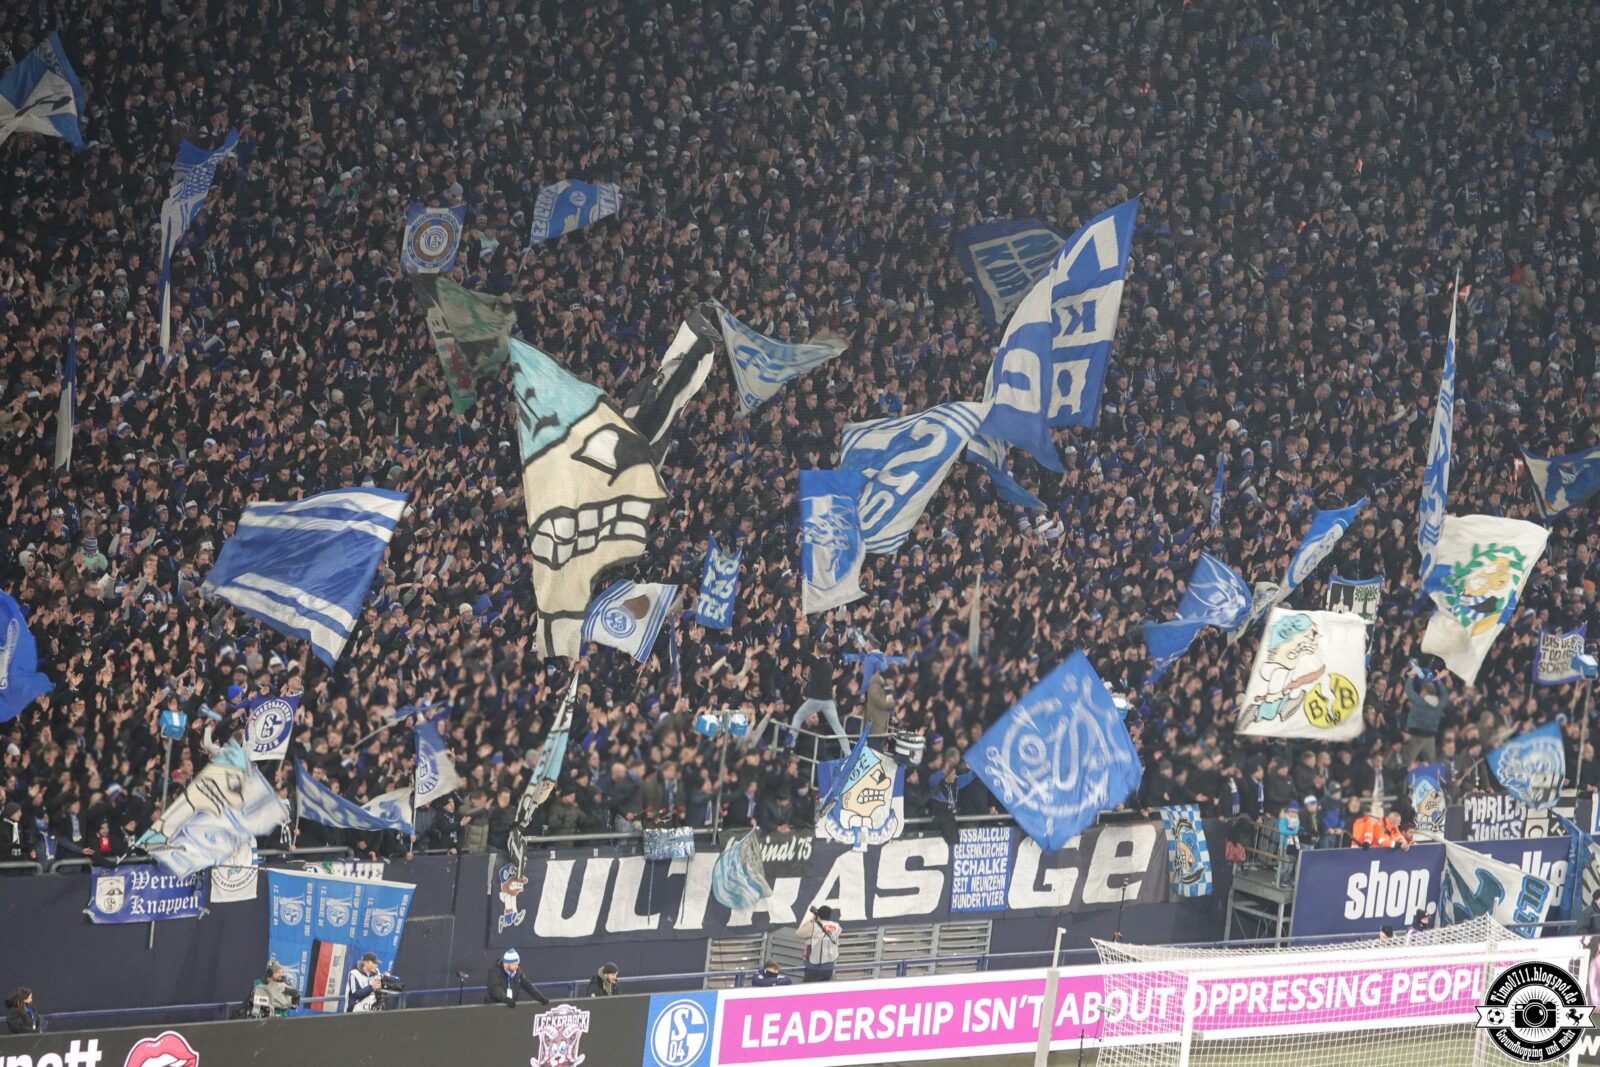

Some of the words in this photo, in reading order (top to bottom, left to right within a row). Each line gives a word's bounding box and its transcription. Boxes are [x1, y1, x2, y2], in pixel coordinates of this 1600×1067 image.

[959, 828, 1010, 842] USSBALLCLUB
[798, 837, 813, 859] 75
[954, 842, 1008, 859] GELSENKIRCHEN
[954, 858, 1007, 876] SCHALKE
[131, 871, 197, 890] Werrata
[953, 877, 968, 893] SEIT
[971, 875, 1006, 892] NEUNZEHN
[130, 895, 199, 915] Knappen
[952, 891, 1004, 908] HUNDERTVIER
[742, 1001, 954, 1048] LEADERSHIP
[962, 995, 1046, 1033] ISN'T
[1056, 987, 1176, 1026] ABOUT
[1183, 973, 1383, 1018] OPPRESSING
[1390, 966, 1504, 1004] PEOPL
